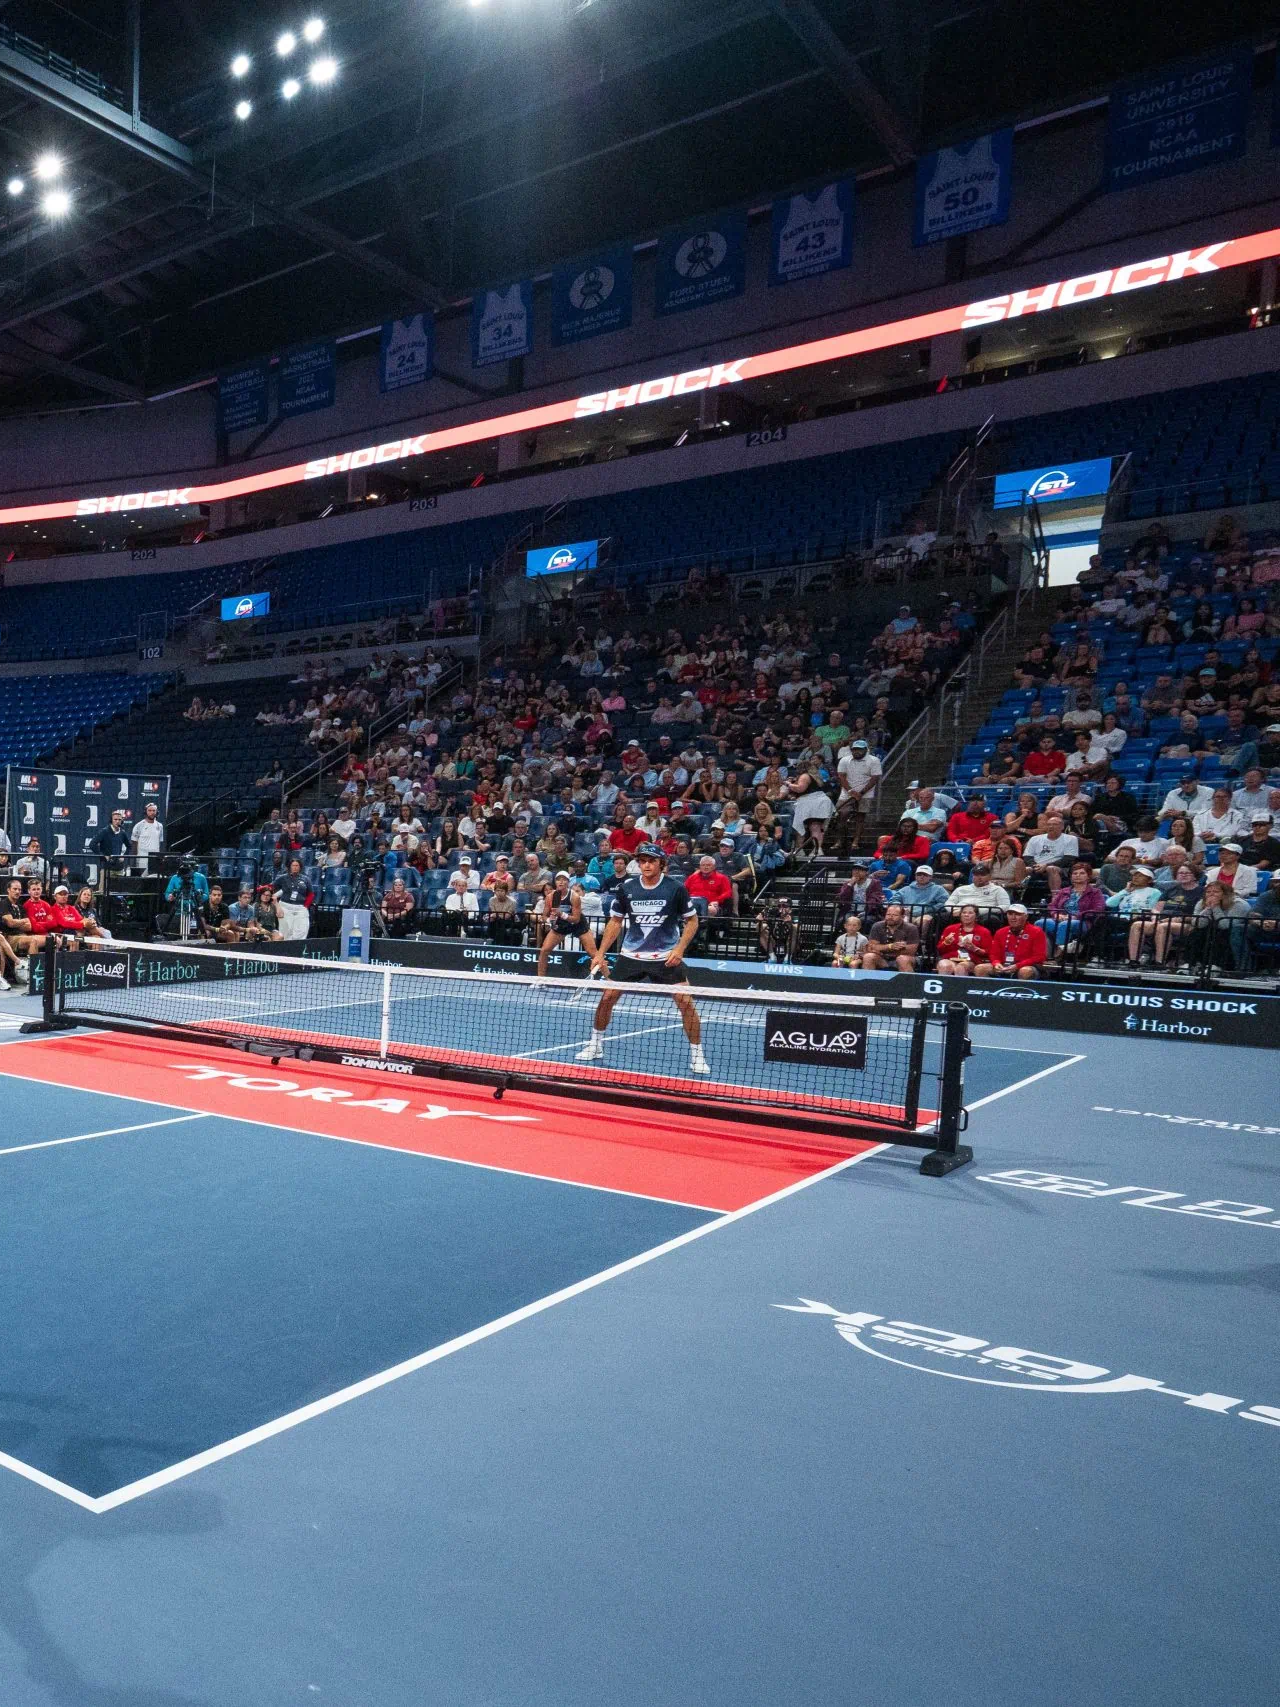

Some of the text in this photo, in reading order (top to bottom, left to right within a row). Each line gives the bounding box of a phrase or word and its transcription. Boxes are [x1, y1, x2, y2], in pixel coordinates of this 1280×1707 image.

[928, 171, 995, 199] SAINT LOUIS
[944, 187, 979, 211] 50
[795, 232, 825, 252] 43
[961, 241, 1231, 328] SHOCK
[492, 324, 513, 341] 34
[397, 352, 415, 368] 24
[574, 358, 751, 418] SHOCK
[750, 430, 784, 445] 204
[304, 434, 431, 480] SHOCK
[1037, 479, 1076, 491] STL
[76, 488, 192, 515] SHOCK
[412, 498, 436, 511] 203
[133, 550, 154, 560] 202
[553, 554, 577, 564] STL
[142, 647, 160, 659] 102
[635, 915, 668, 924] SLICE
[463, 949, 520, 962] CHICAGO
[524, 953, 562, 965] SLCE
[148, 960, 200, 982] Harbor
[717, 961, 727, 969] 2
[764, 964, 803, 975] WINS
[923, 979, 943, 994] 6
[967, 989, 1051, 1000] SHOCK
[1170, 998, 1257, 1015] SHOCK
[1141, 1018, 1212, 1036] Harbor
[769, 1043, 857, 1055] ALKALINE HYDRATION
[341, 1056, 415, 1075] DOMINATOR
[185, 1068, 484, 1120] TORAY
